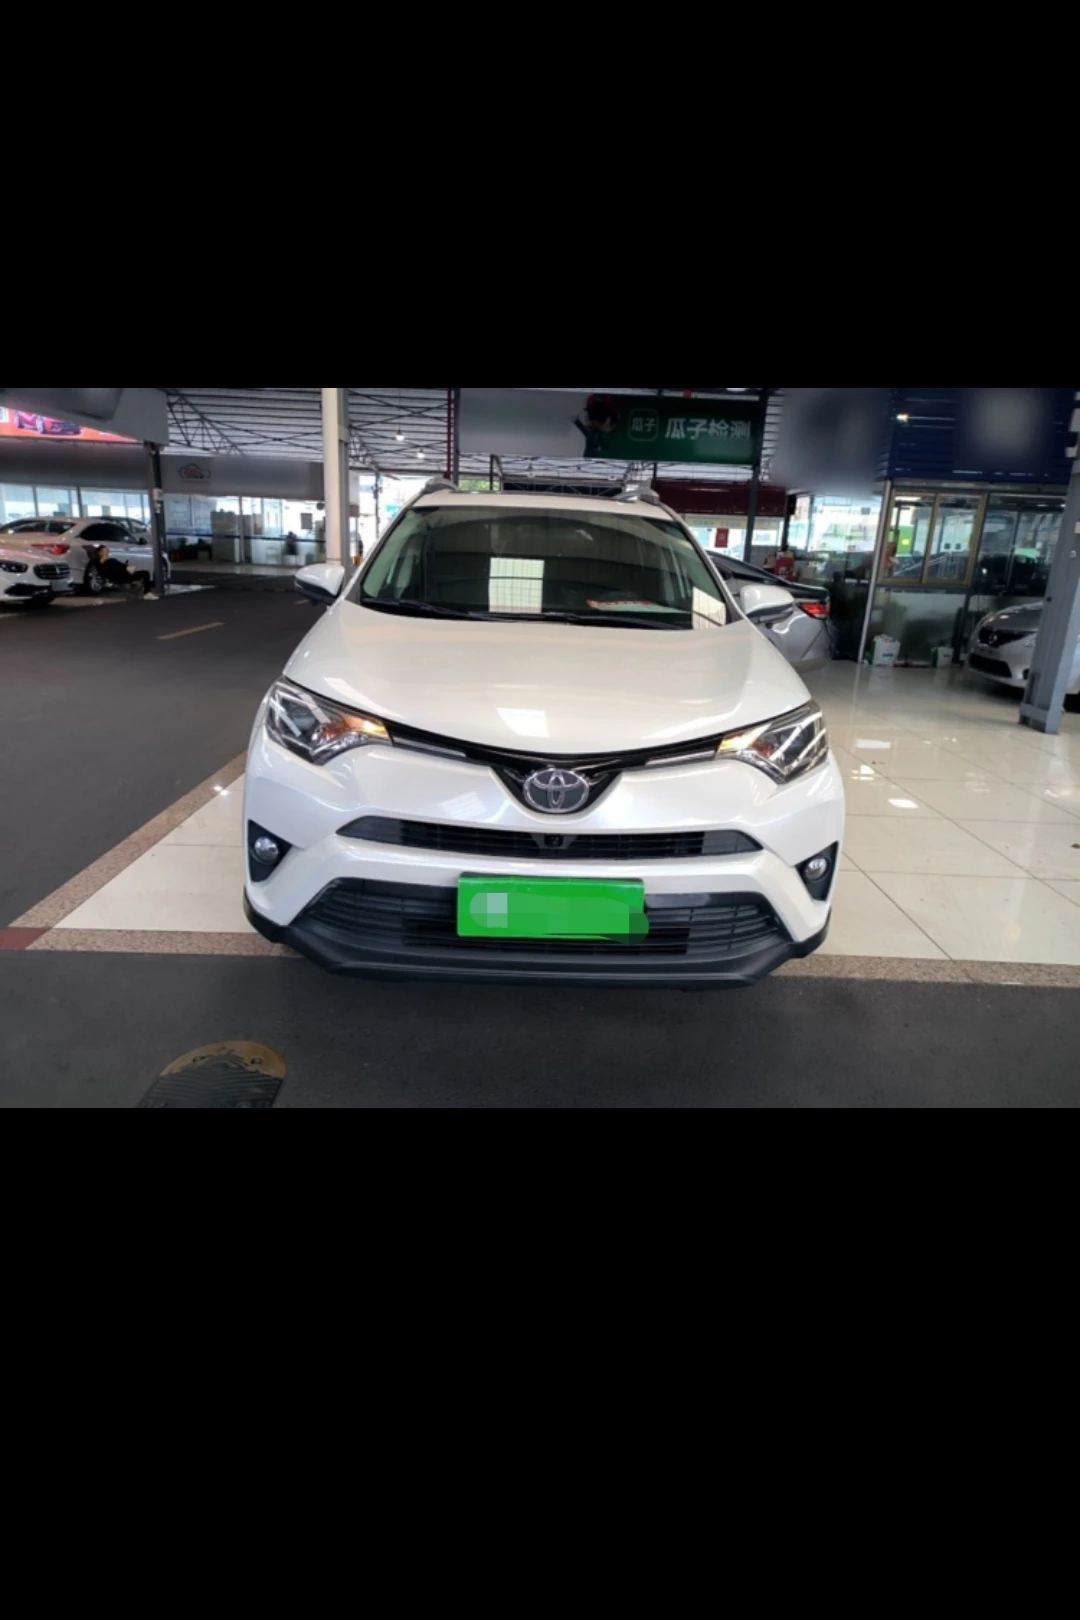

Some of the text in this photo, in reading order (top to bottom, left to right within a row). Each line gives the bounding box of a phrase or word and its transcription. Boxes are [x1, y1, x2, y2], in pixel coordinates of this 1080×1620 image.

[631, 417, 656, 432] 瓜子
[665, 418, 751, 441] 瓜子检测
